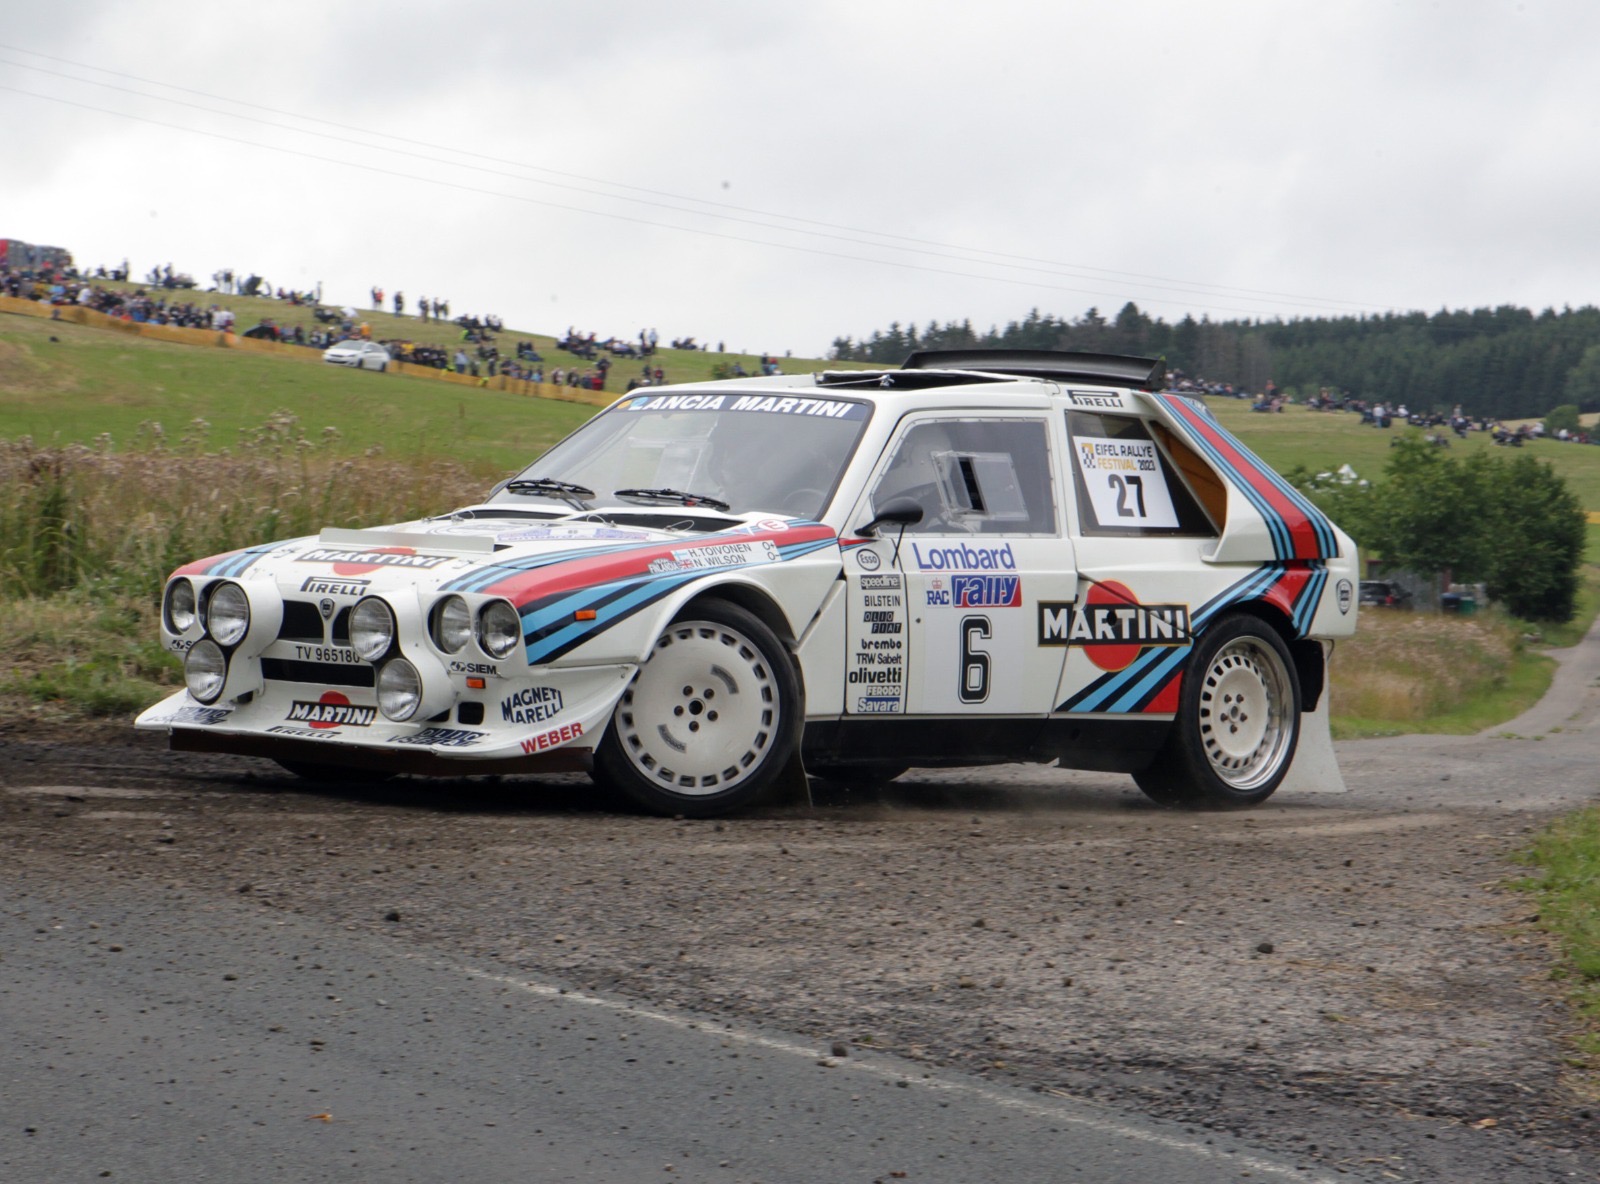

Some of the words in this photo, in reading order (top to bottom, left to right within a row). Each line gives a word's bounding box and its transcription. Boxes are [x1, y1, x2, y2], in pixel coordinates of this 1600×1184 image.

[1067, 389, 1124, 408] PIRELLI
[730, 396, 855, 418] MARTINI
[1095, 442, 1118, 456] EIFEL
[1120, 444, 1154, 459] RALLYE
[1098, 458, 1137, 471] FESTIVAL
[1138, 459, 1157, 472] 2023
[1108, 474, 1147, 518] 27
[302, 550, 447, 568] MARTINI
[703, 554, 747, 567] WILSON
[860, 554, 878, 564] Esso
[912, 542, 1016, 569] Lombard
[300, 576, 372, 597] PIRELLI
[927, 590, 949, 605] RAC
[953, 575, 1019, 607] rally
[864, 595, 901, 607] BILSTEIN
[865, 611, 894, 622] OLIO
[1043, 608, 1186, 640] MARTINI
[872, 623, 902, 633] FIAT
[295, 645, 312, 660] TV
[861, 639, 902, 650] brembo
[856, 653, 876, 665] TRW
[877, 653, 902, 665] Sabelt
[958, 614, 993, 704] 6
[467, 662, 497, 675] SIEM
[849, 667, 902, 684] olivetti
[866, 686, 901, 696] FERODO
[858, 698, 900, 712] Savara
[290, 703, 375, 726] MARTINI
[265, 726, 342, 739] PIRELLI
[520, 722, 584, 755] WEBER
